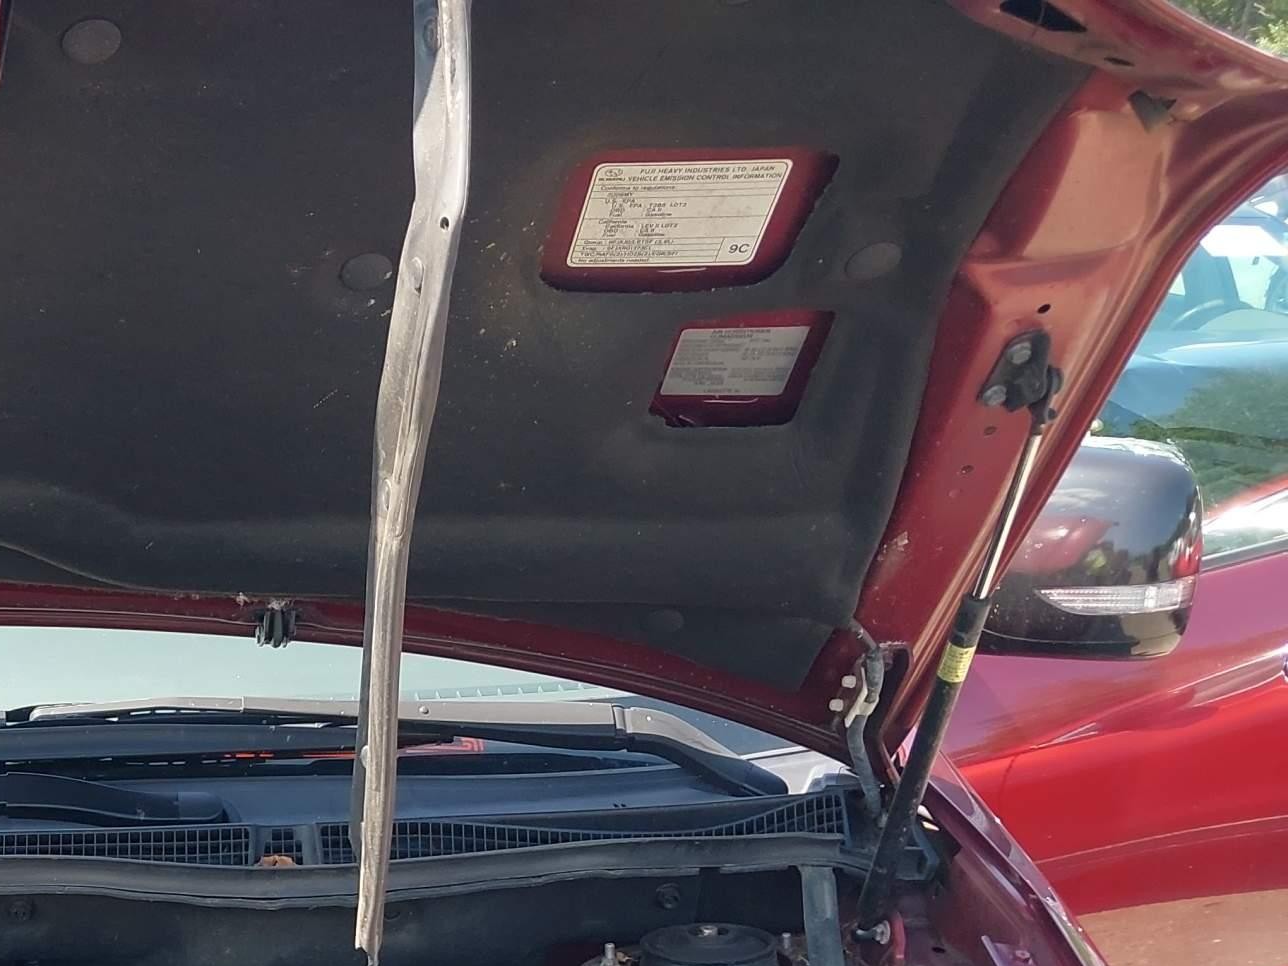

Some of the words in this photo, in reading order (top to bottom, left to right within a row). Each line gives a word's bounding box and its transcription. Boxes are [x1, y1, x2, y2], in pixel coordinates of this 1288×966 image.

[696, 173, 729, 181] CONTROL
[732, 172, 783, 180] INFORMATION
[728, 243, 750, 254] 9C
